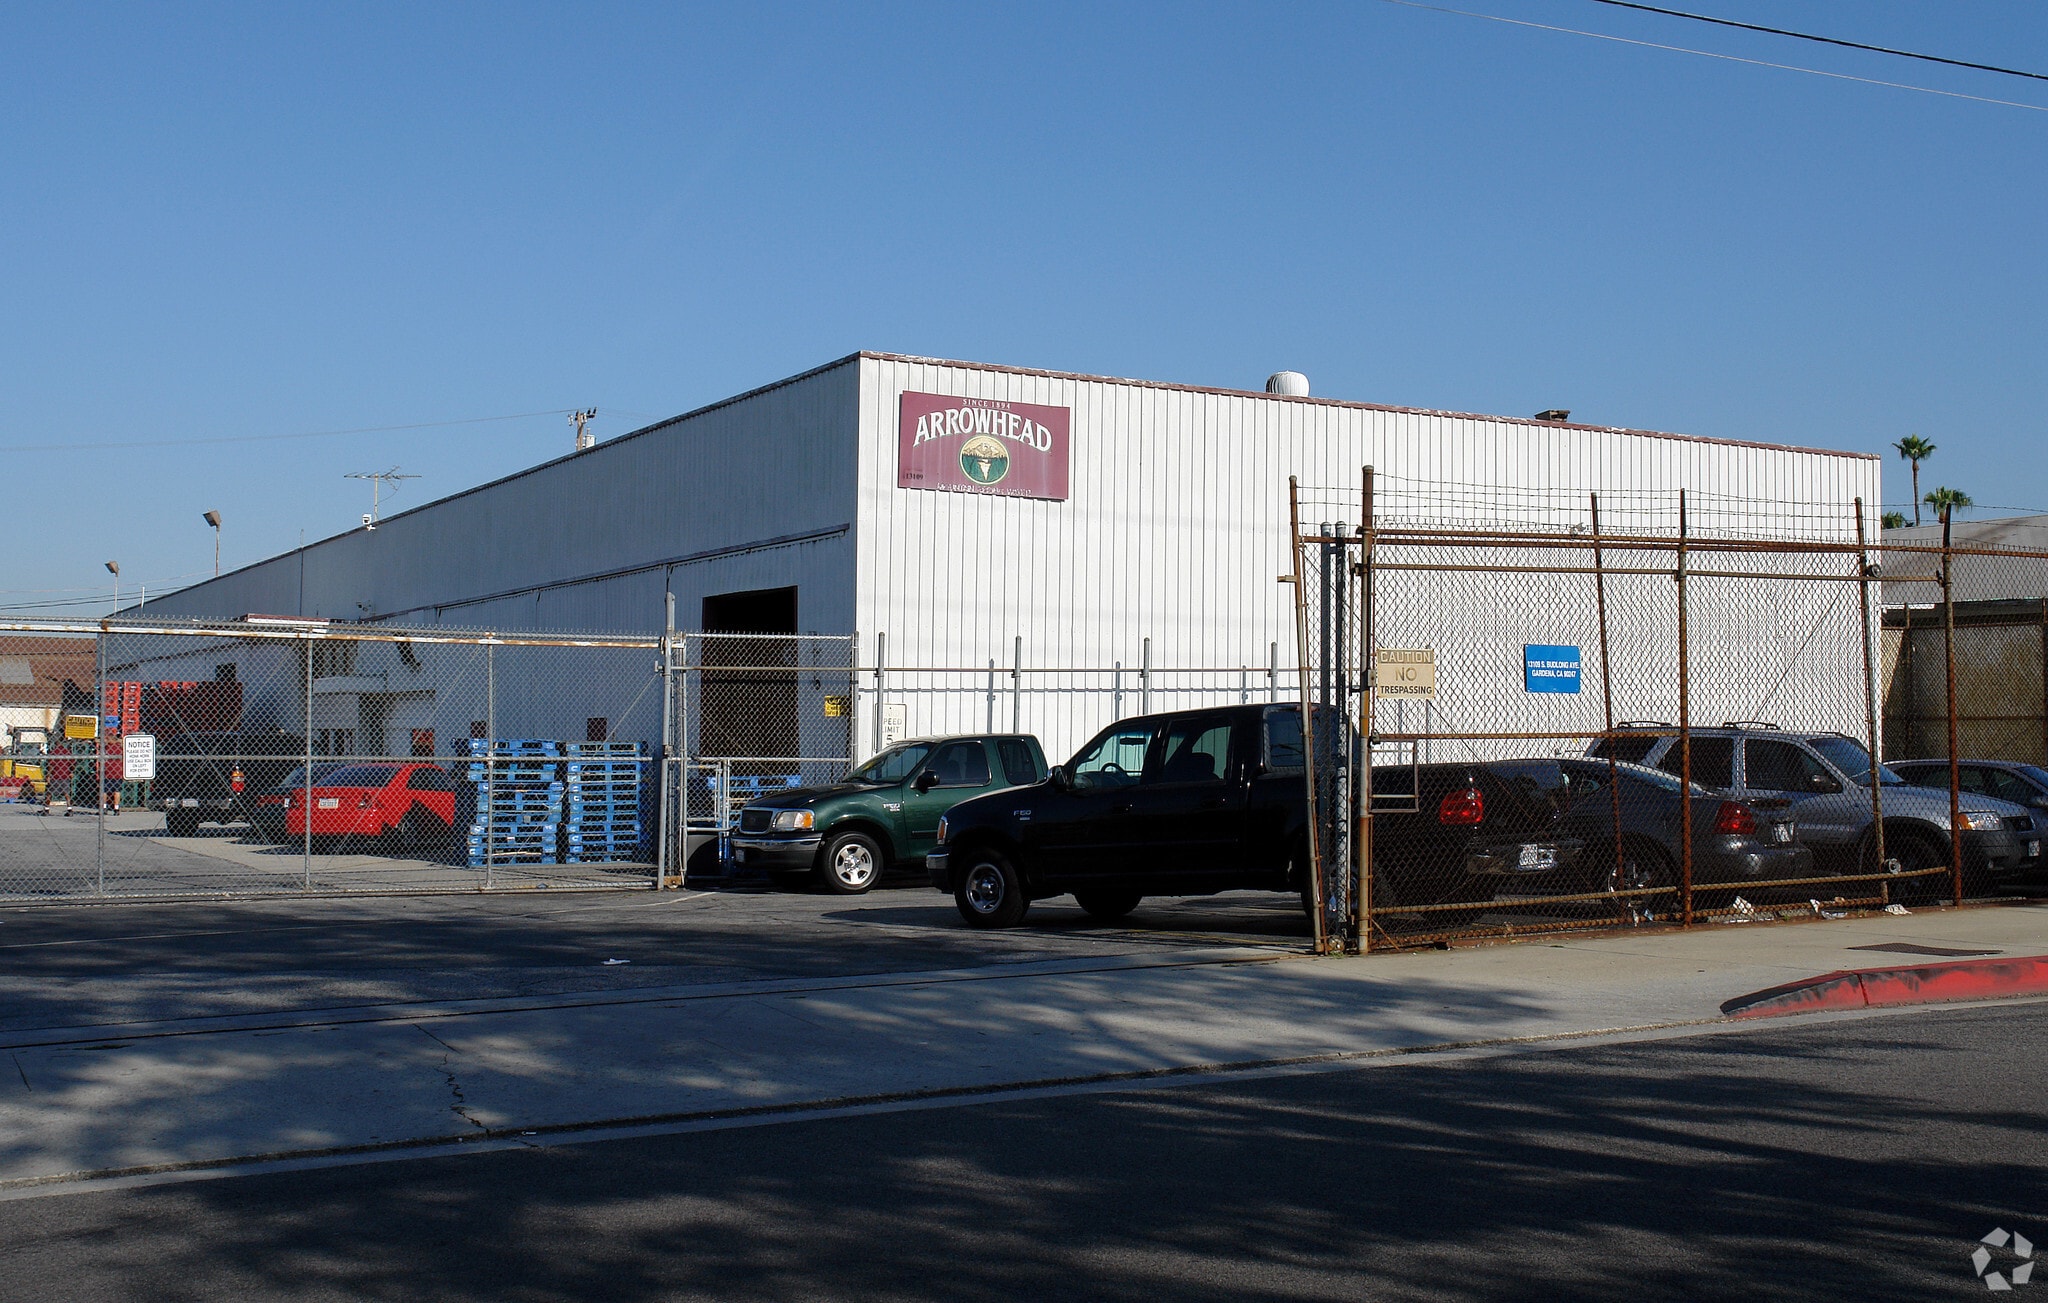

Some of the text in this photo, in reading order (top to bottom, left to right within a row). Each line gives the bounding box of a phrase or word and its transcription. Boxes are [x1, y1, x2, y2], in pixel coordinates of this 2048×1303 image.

[962, 399, 988, 407] SINCE
[913, 407, 1052, 452] ARROWHEAD
[1380, 651, 1431, 662] CAUTION
[1395, 667, 1417, 681] NO
[1380, 685, 1433, 695] TRESPASSING
[881, 717, 903, 725] PEED
